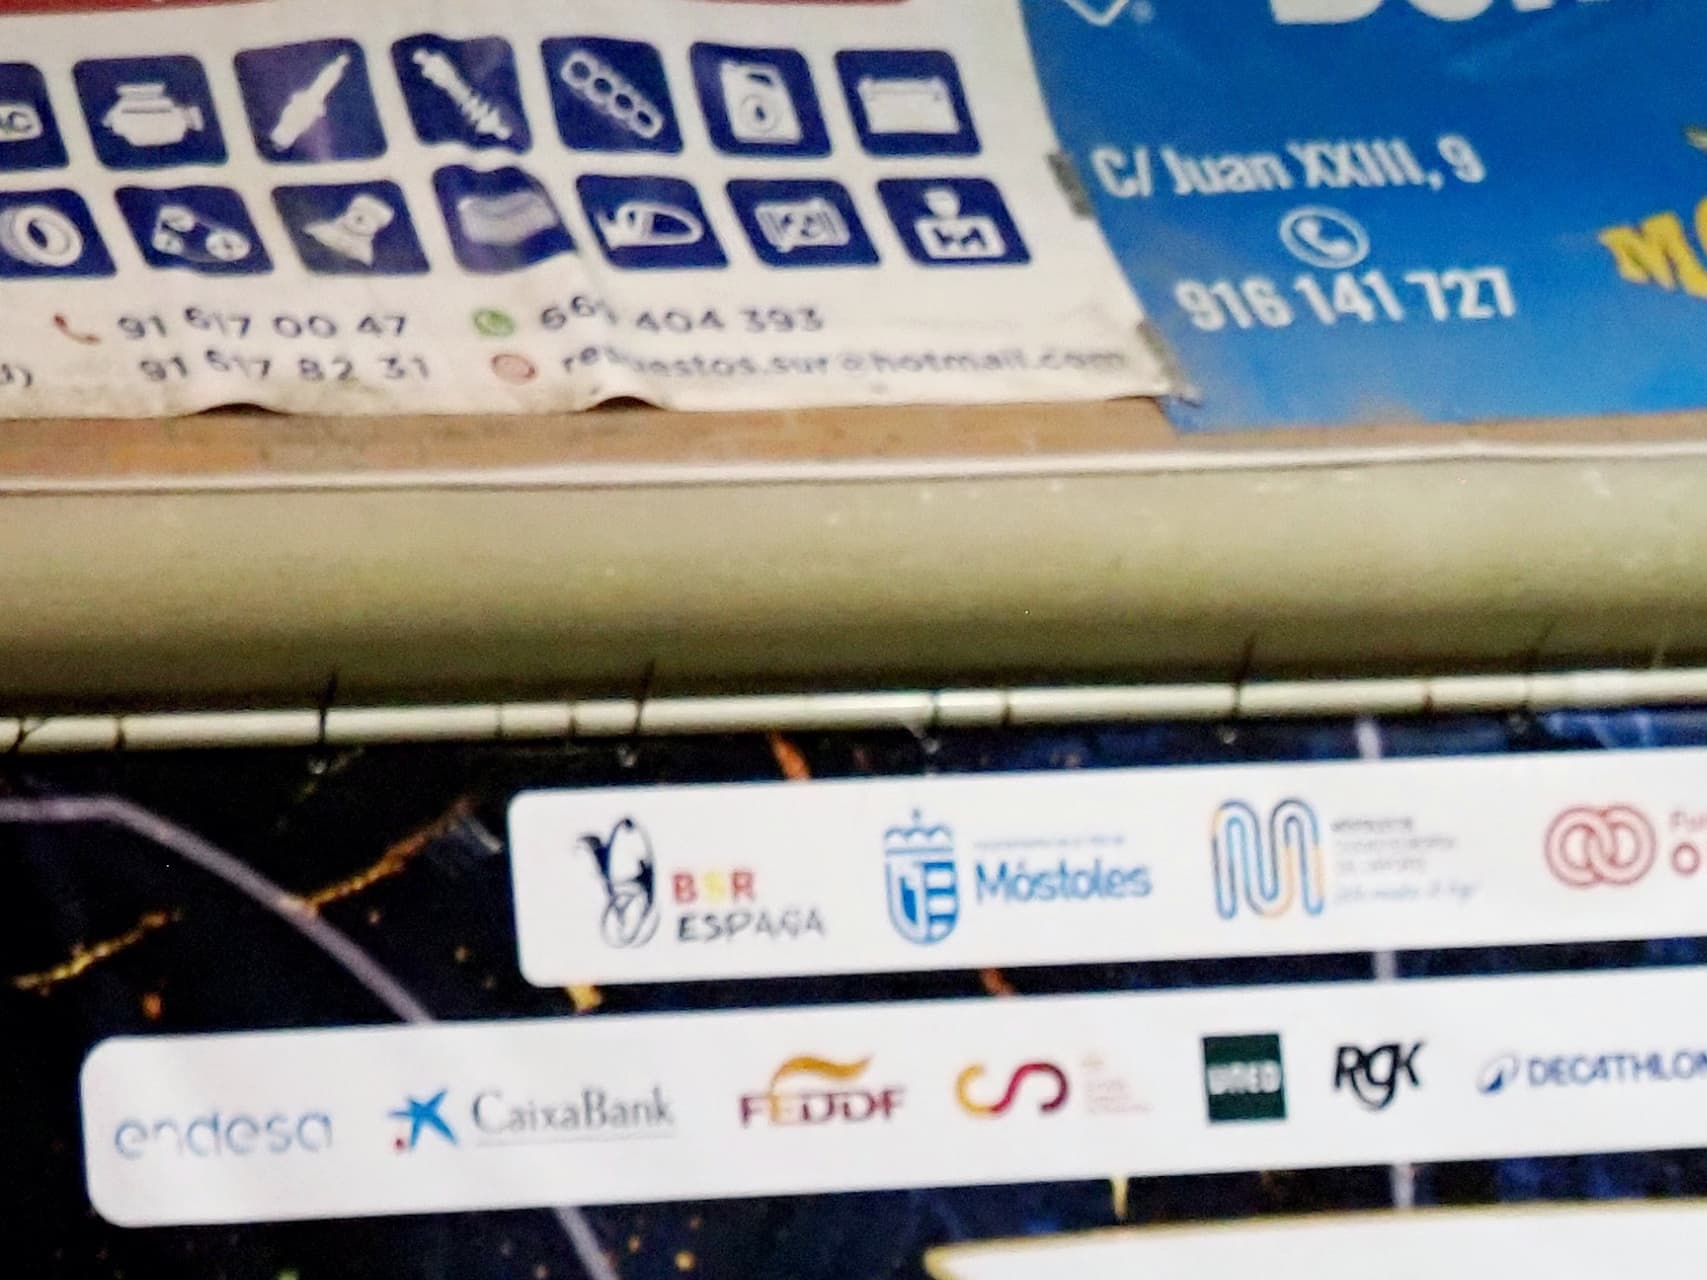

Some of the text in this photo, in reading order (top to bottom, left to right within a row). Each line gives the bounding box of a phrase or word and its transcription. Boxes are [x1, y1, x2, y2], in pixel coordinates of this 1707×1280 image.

[1092, 146, 1150, 198] C/
[1161, 148, 1292, 196] Juan
[1437, 134, 1486, 184] 9
[636, 304, 724, 334] 404
[1176, 266, 1518, 332] 916 141 727
[272, 312, 338, 340] 00
[356, 312, 406, 338] 47
[672, 868, 756, 906] BSR
[972, 858, 1156, 904] Móstoles
[114, 1110, 334, 1160] endesa
[472, 1086, 676, 1136] CaixaBank
